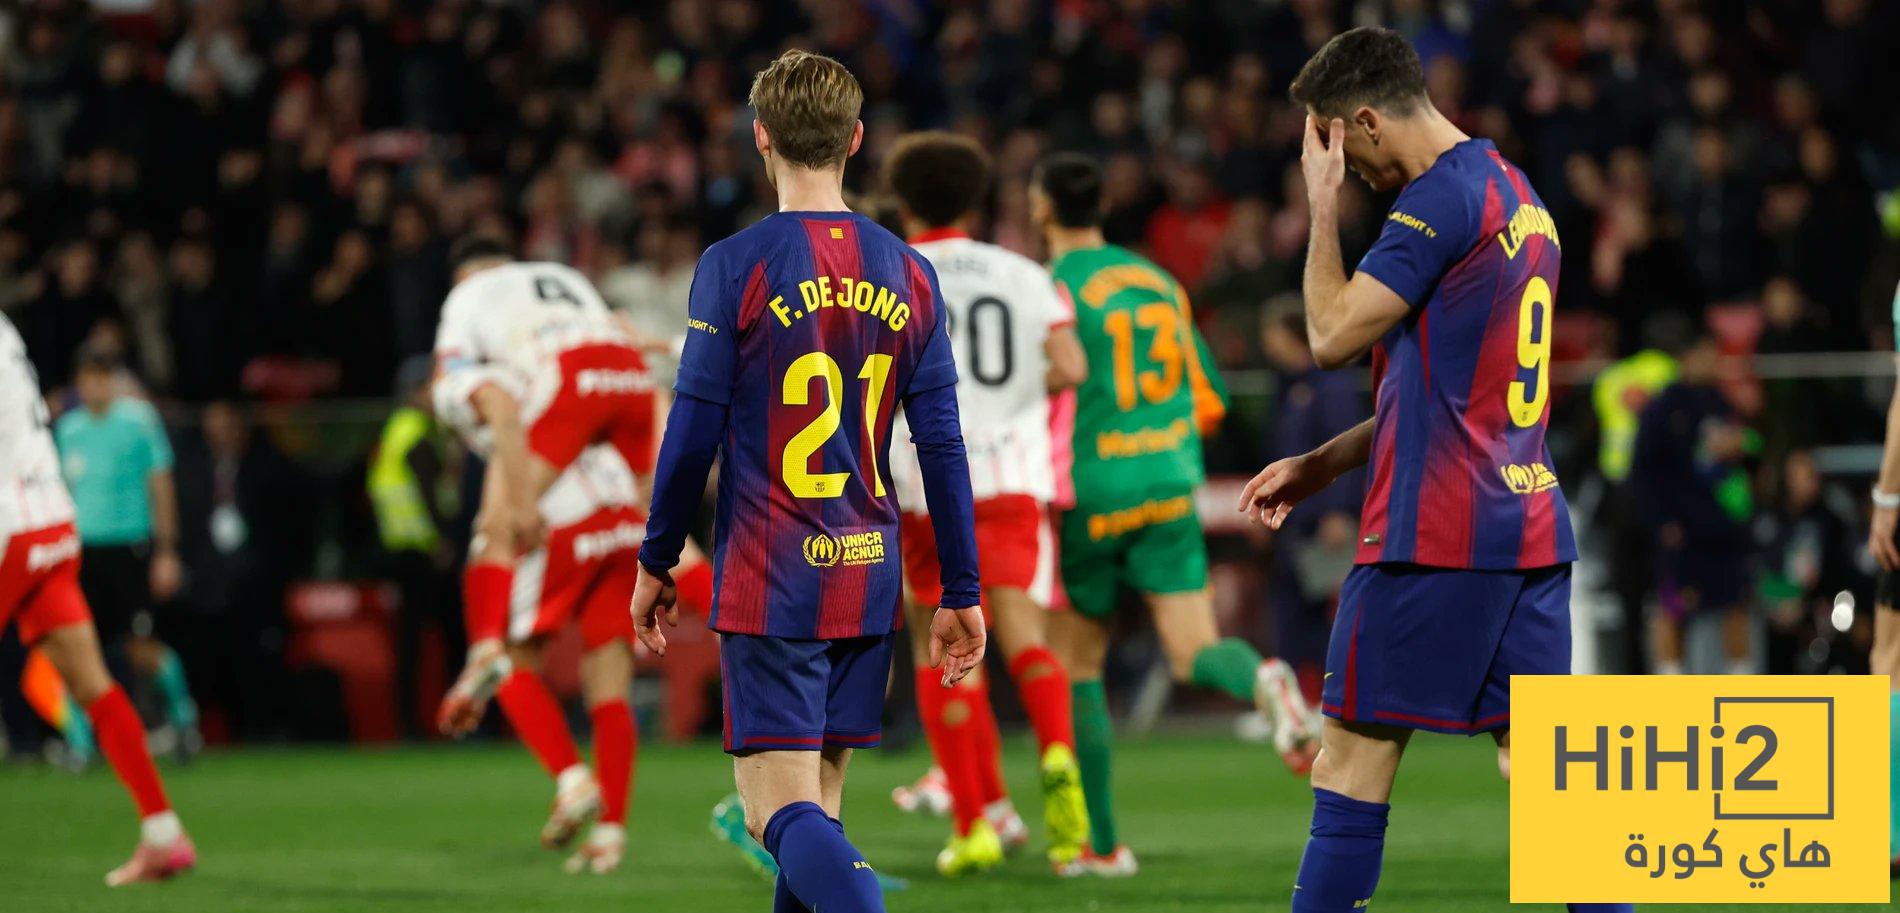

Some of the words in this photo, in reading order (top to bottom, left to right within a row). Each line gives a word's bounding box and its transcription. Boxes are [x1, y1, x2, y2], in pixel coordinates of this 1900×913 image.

[768, 295, 803, 328] F.
[798, 276, 834, 313] DE
[836, 277, 911, 332] JONG
[1103, 301, 1184, 412] 13
[1506, 275, 1553, 429] 9
[782, 351, 893, 499] 21
[841, 531, 883, 549] UNHCR
[842, 544, 884, 561] ACNUR
